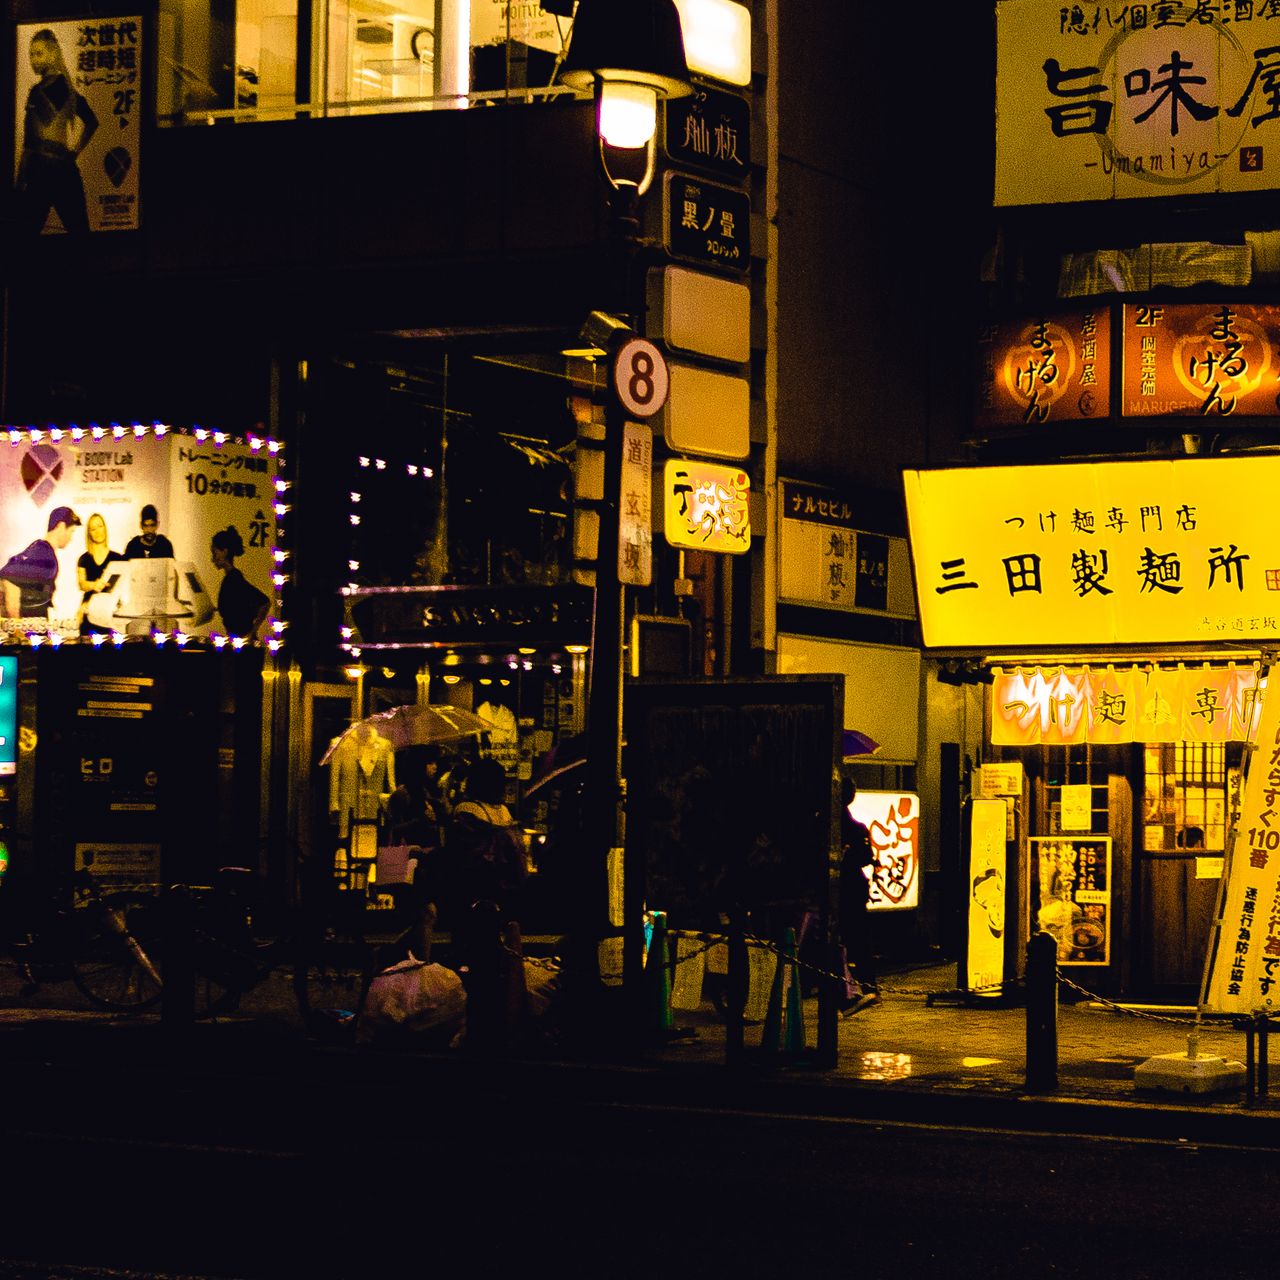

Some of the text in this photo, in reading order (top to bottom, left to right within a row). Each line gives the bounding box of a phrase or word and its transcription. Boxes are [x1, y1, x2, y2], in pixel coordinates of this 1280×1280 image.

[79, 22, 136, 46] 次世代
[113, 89, 135, 115] 2F
[1135, 305, 1164, 328] 2F
[1078, 313, 1098, 388] 居酒屋
[1189, 306, 1249, 417] まるげん
[629, 351, 656, 405] 8
[1016, 319, 1060, 424] まるげん
[248, 522, 270, 548] 2F
[1004, 504, 1198, 535] つけ麺専門店
[935, 544, 1251, 598] 三田製麺所
[1003, 690, 1128, 726] つけ麺
